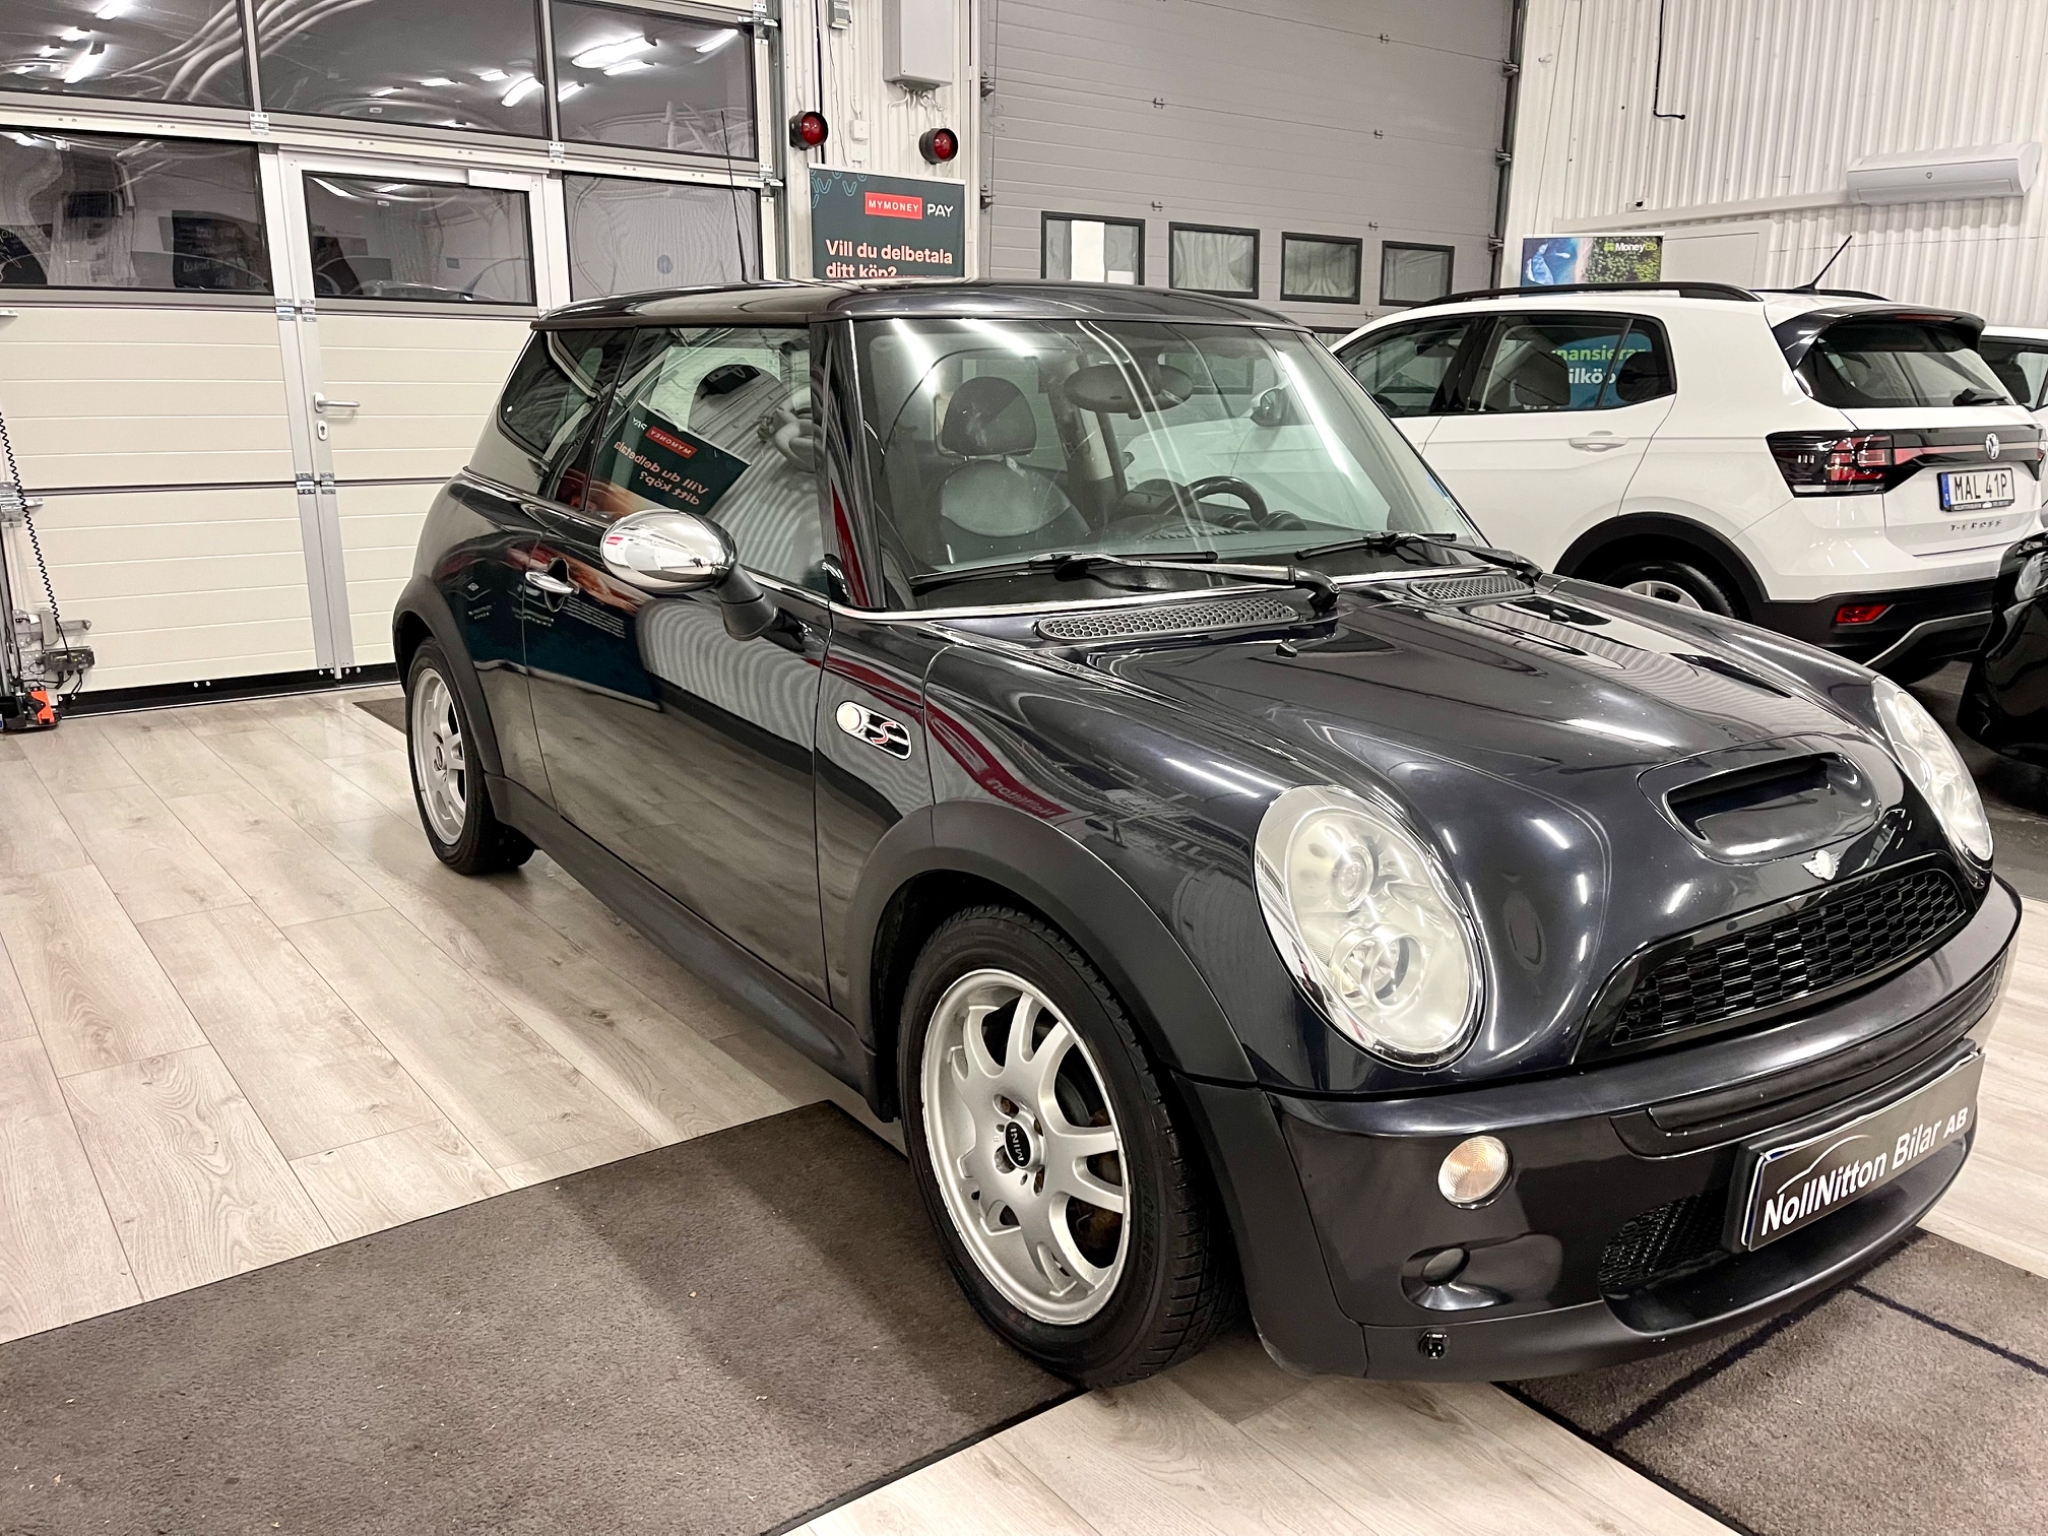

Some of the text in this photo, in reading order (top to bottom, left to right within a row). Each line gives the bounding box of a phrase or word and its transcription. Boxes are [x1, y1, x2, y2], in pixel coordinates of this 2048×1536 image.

[868, 199, 954, 217] MYMONEY PAY
[826, 239, 953, 264] Vill du delbetala
[826, 261, 855, 278] ditt
[1954, 473, 2007, 501] MAL 41P
[1010, 1128, 1025, 1161] MINI
[1761, 1107, 1969, 1236] NollNitton Bilar AB
